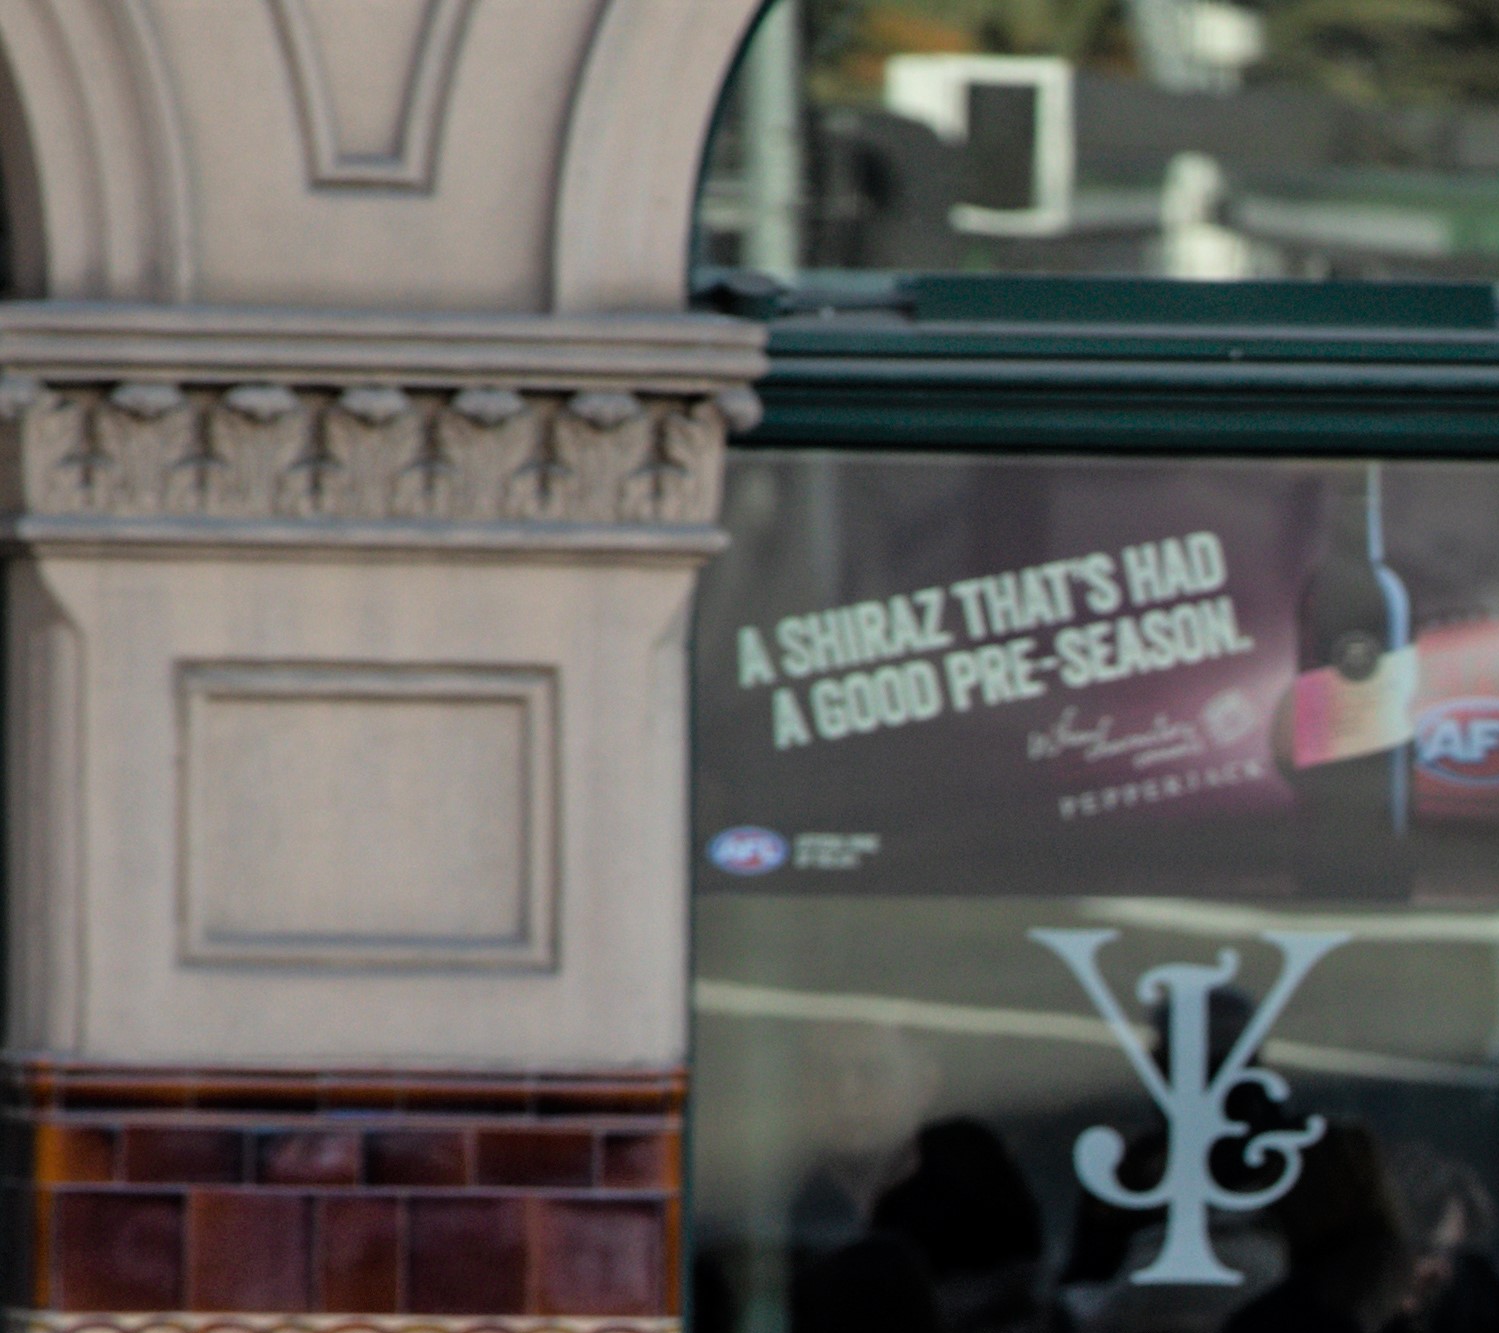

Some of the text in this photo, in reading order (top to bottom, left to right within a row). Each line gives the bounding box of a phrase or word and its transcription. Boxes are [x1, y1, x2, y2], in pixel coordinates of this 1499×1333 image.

[737, 531, 1228, 688] A SHIRAZ THAT'S HAD
[771, 688, 811, 751] A
[810, 660, 942, 740] GOOD
[943, 597, 1255, 712] PRE-SEASON.
